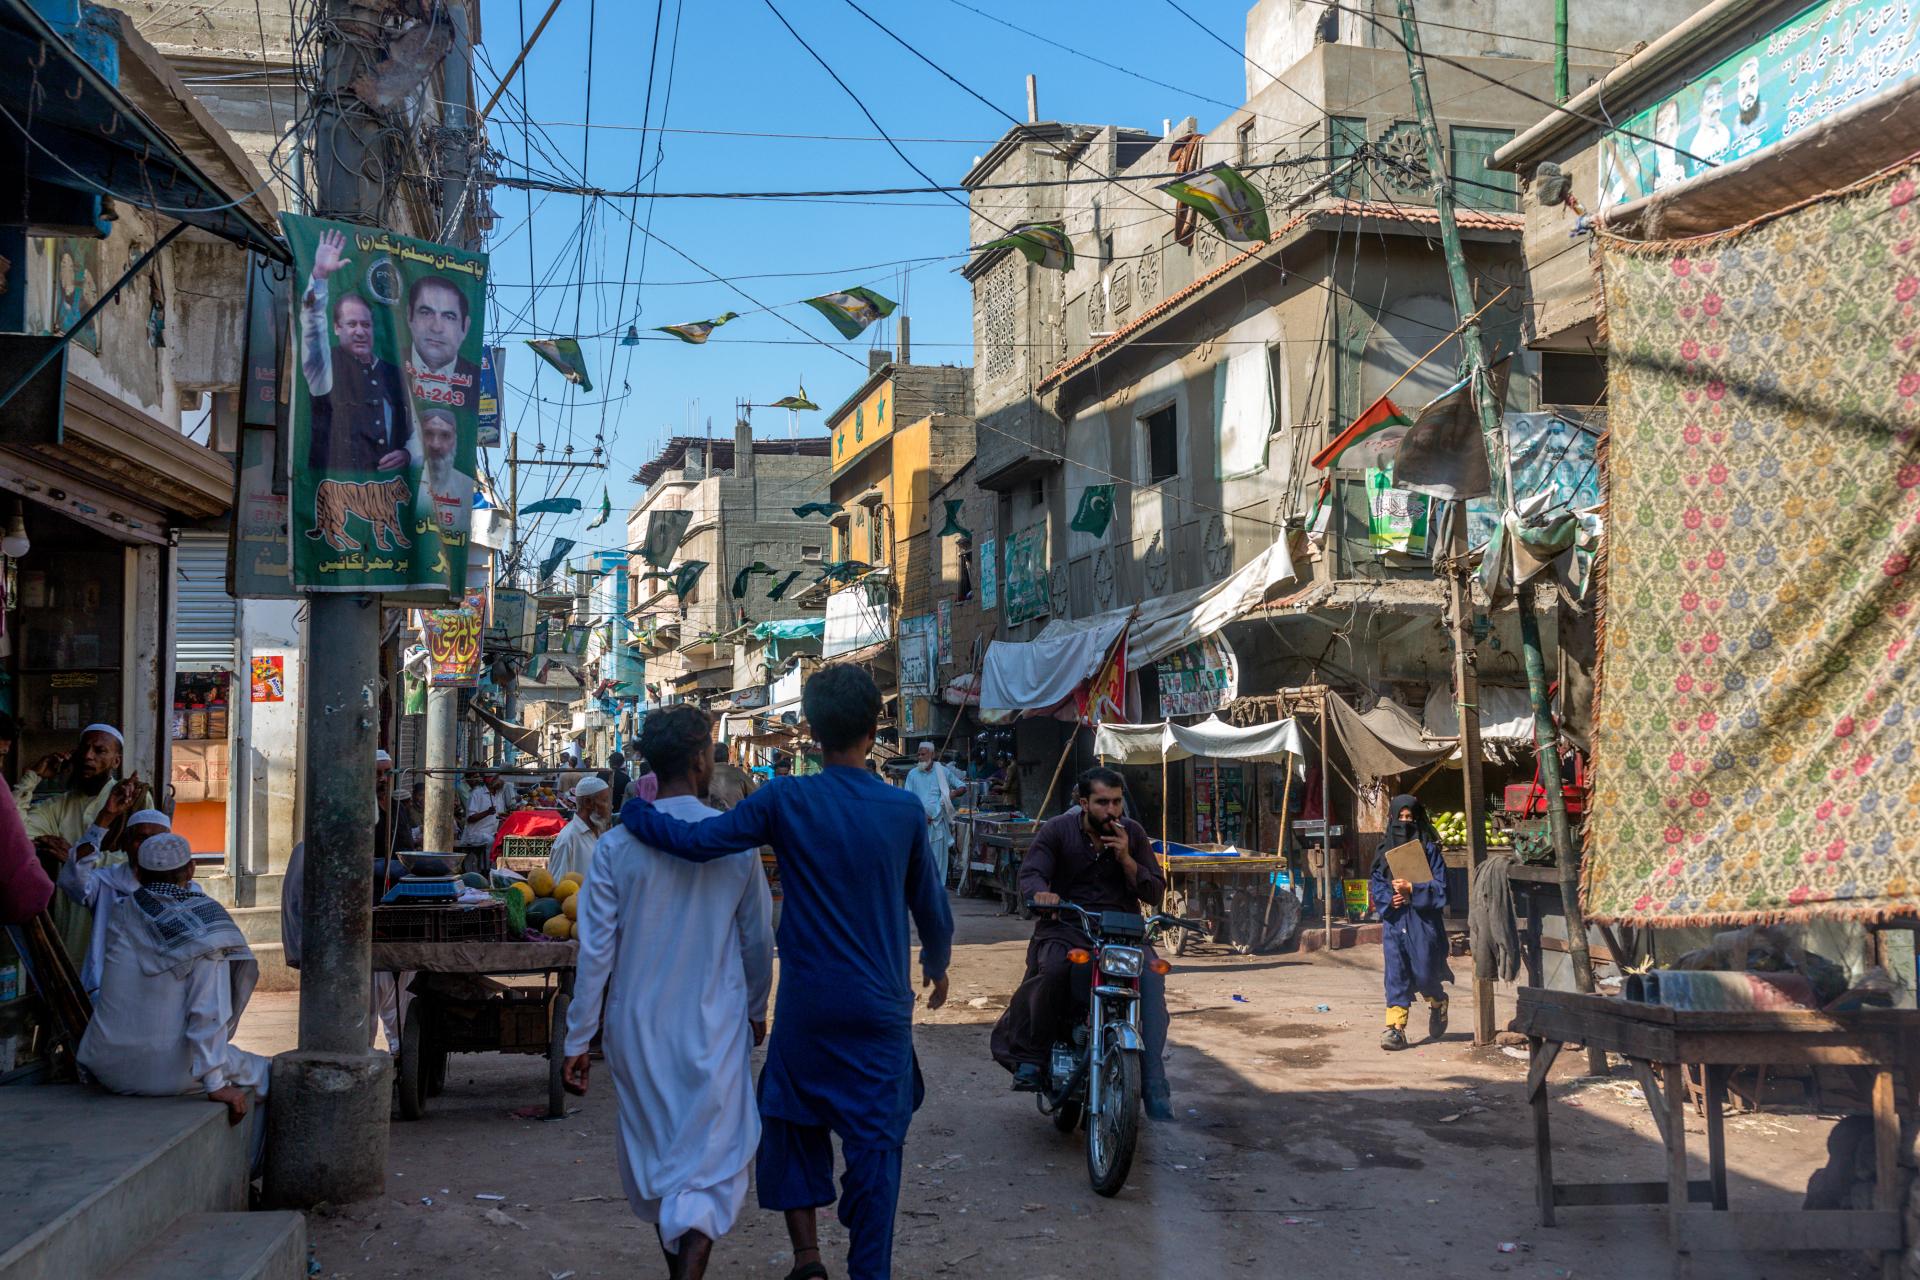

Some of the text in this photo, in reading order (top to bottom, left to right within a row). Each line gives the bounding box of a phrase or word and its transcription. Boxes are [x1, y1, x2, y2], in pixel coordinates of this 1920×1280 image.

[374, 233, 401, 256] لیگ
[400, 246, 435, 265] مسلم
[435, 254, 484, 281] پاکستان
